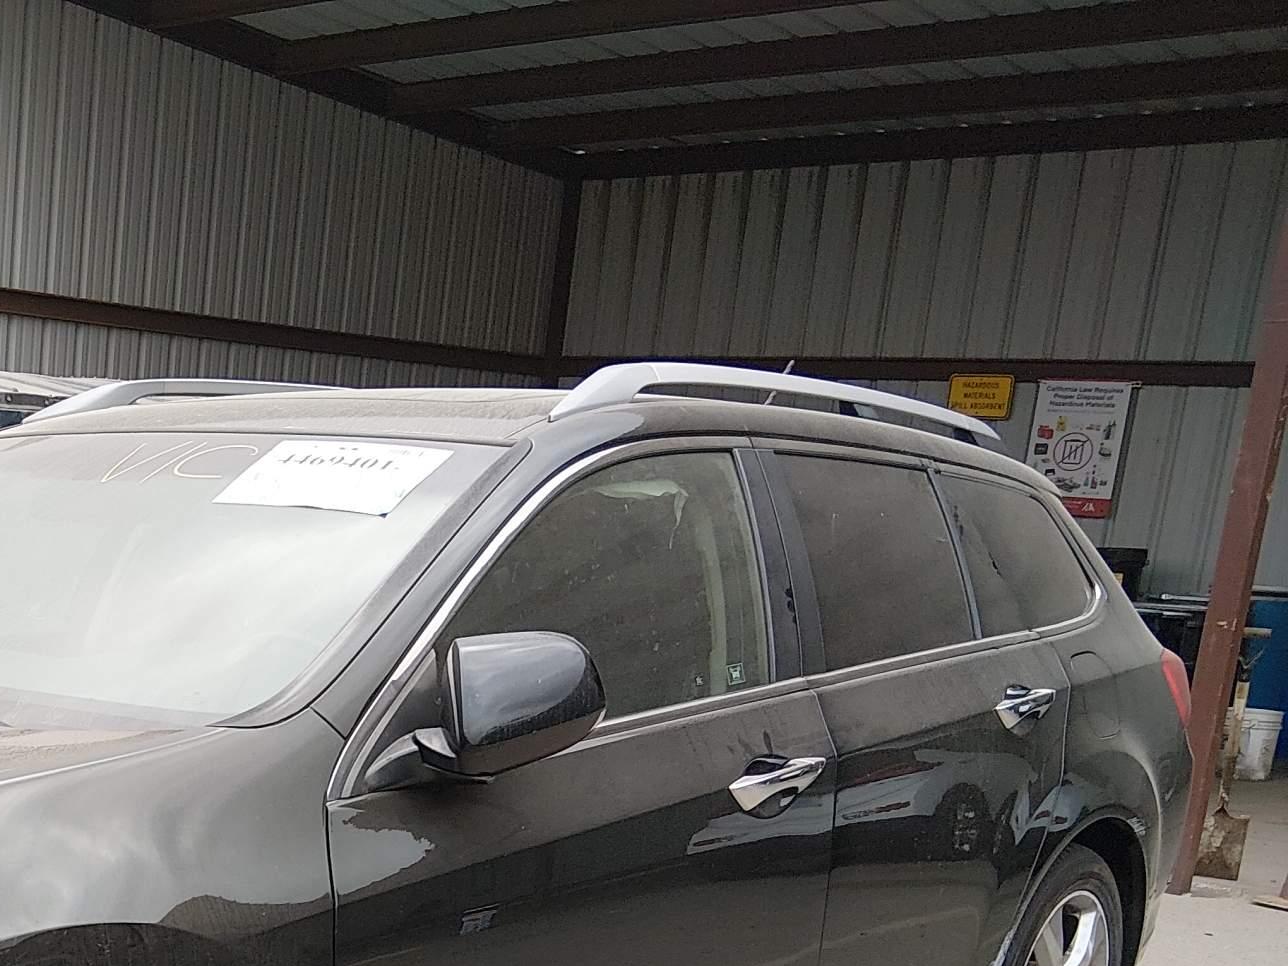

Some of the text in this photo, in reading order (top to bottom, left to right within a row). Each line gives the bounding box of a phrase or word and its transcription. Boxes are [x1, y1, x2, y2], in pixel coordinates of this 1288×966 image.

[1046, 385, 1078, 393] California
[1053, 393, 1075, 401] Proper
[1049, 400, 1116, 409] Hazardous Materials
